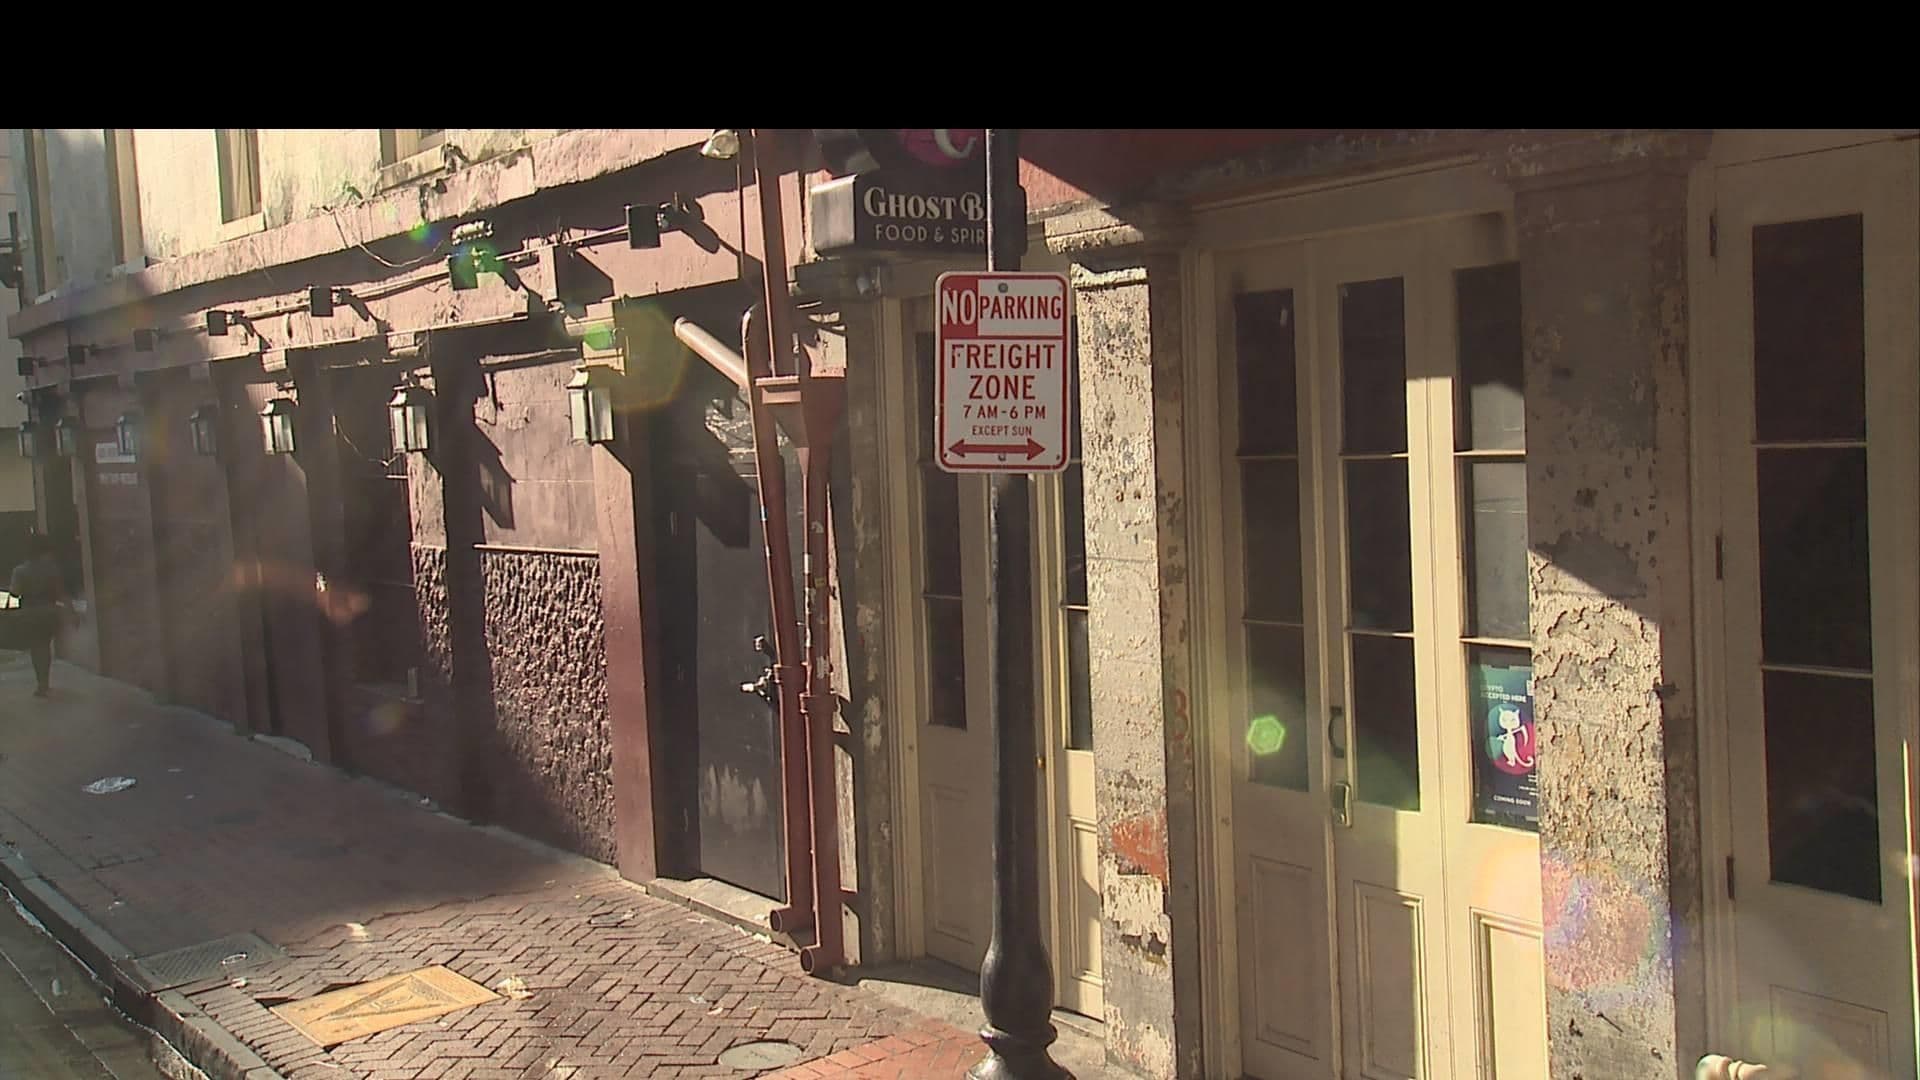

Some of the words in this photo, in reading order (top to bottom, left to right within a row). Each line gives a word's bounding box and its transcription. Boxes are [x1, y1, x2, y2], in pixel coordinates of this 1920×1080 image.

[863, 186, 956, 220] GHOST
[960, 192, 987, 221] B
[876, 224, 927, 242] FOOD
[934, 227, 944, 243] &
[951, 227, 985, 245] SPIR
[942, 289, 977, 326] NO
[979, 295, 1062, 320] PARKING
[951, 343, 1056, 369] FREIGHT
[969, 375, 1036, 400] ZONE
[963, 405, 972, 419] 7
[1025, 405, 1046, 419] PM
[972, 425, 1008, 436] EXCEPT
[1011, 425, 1032, 436] SUN
